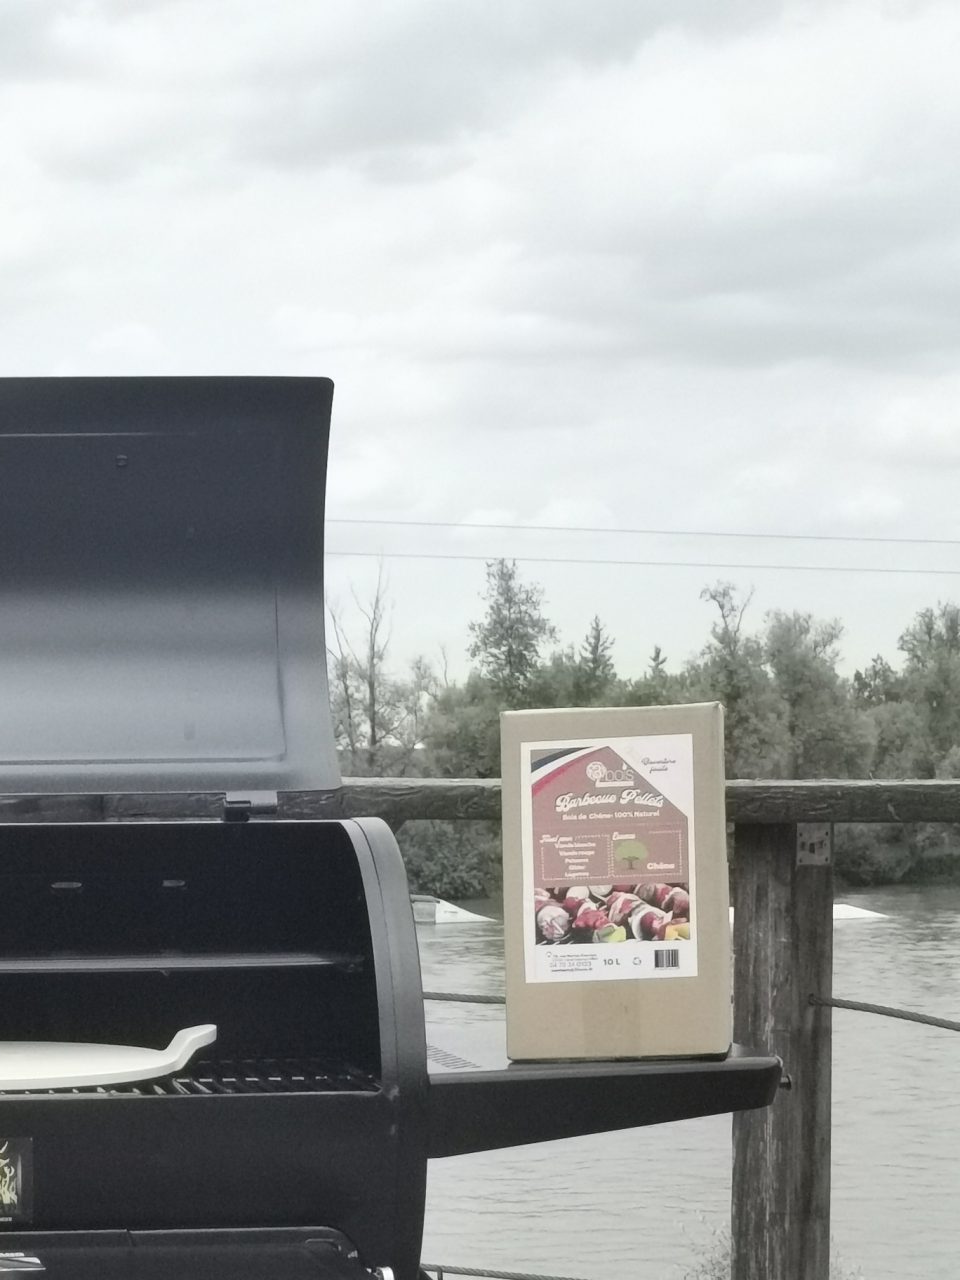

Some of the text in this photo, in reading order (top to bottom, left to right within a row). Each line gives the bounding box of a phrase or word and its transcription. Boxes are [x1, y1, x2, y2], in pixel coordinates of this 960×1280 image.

[555, 789, 664, 812] Barbecue Pellets
[603, 958, 621, 966] 10 L
